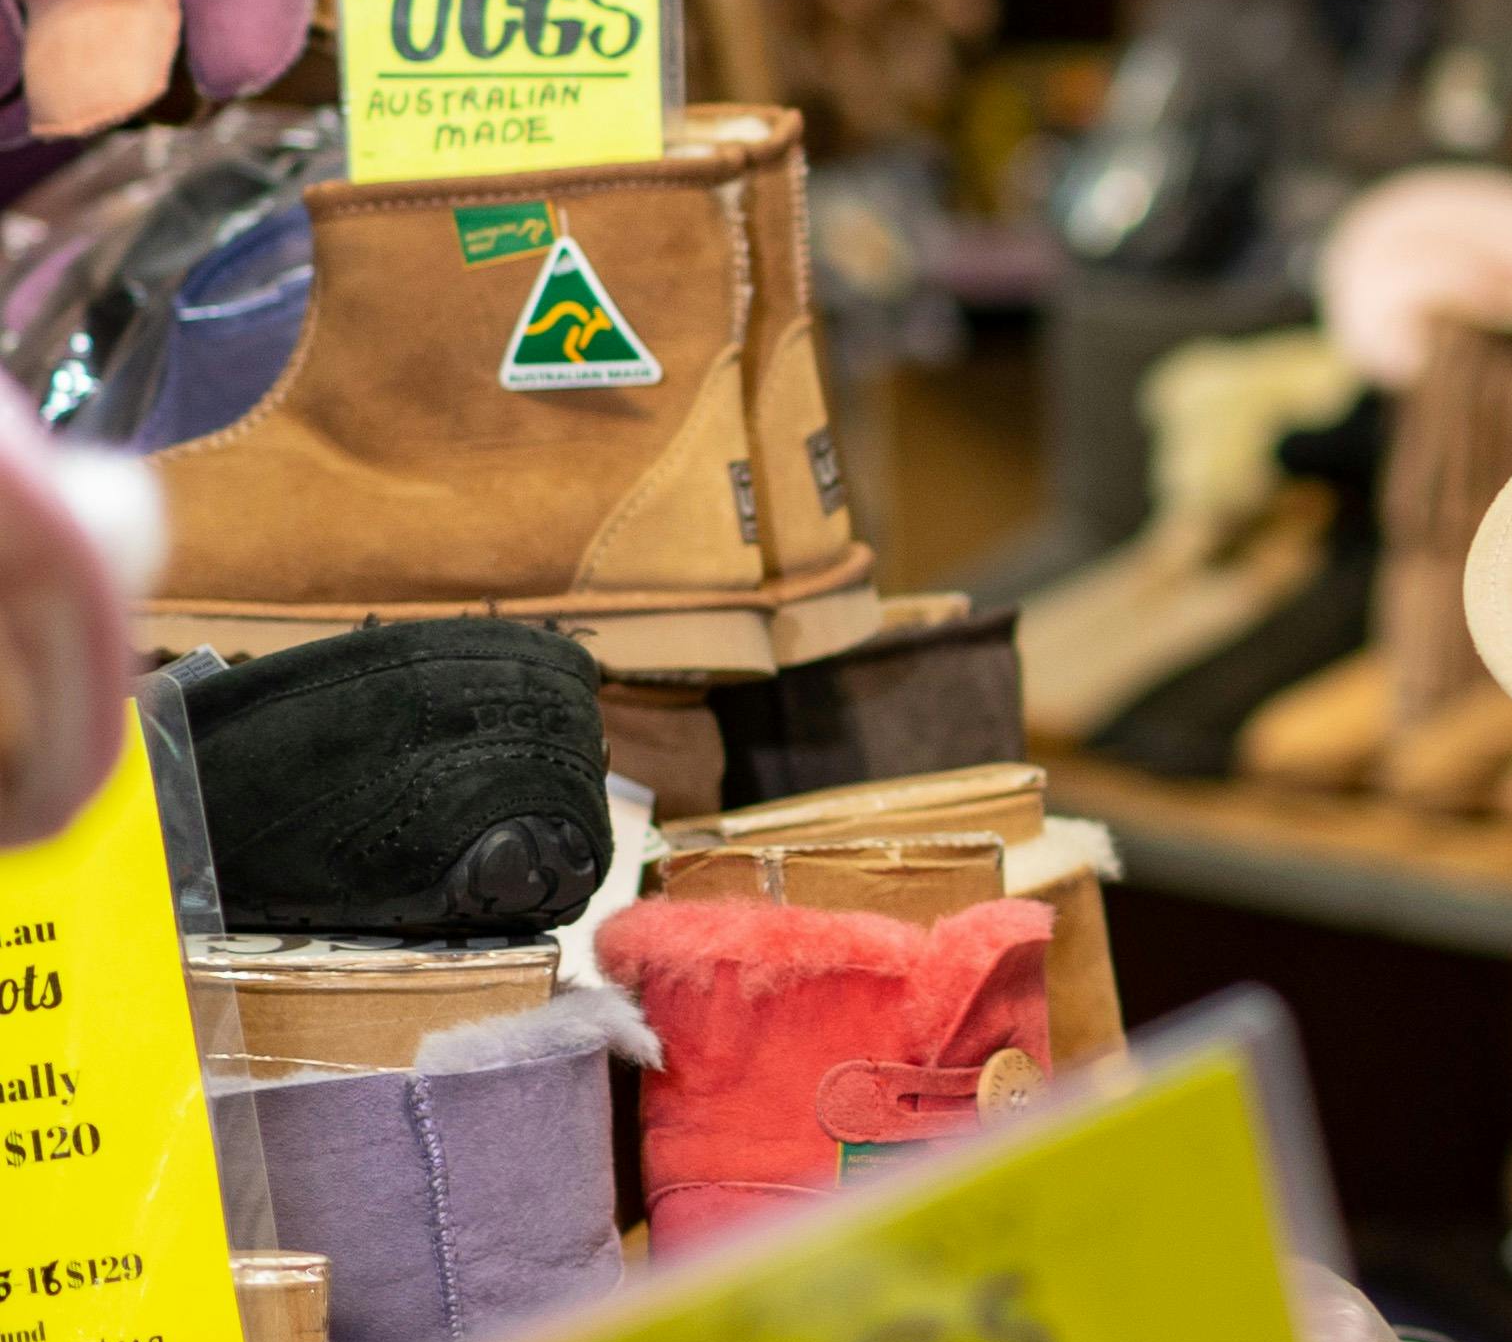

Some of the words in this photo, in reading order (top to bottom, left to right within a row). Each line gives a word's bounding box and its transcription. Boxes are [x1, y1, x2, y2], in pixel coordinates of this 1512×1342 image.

[367, 83, 582, 120] AUSTRALIAN
[434, 116, 555, 152] MADE
[4, 1121, 101, 1169] $120
